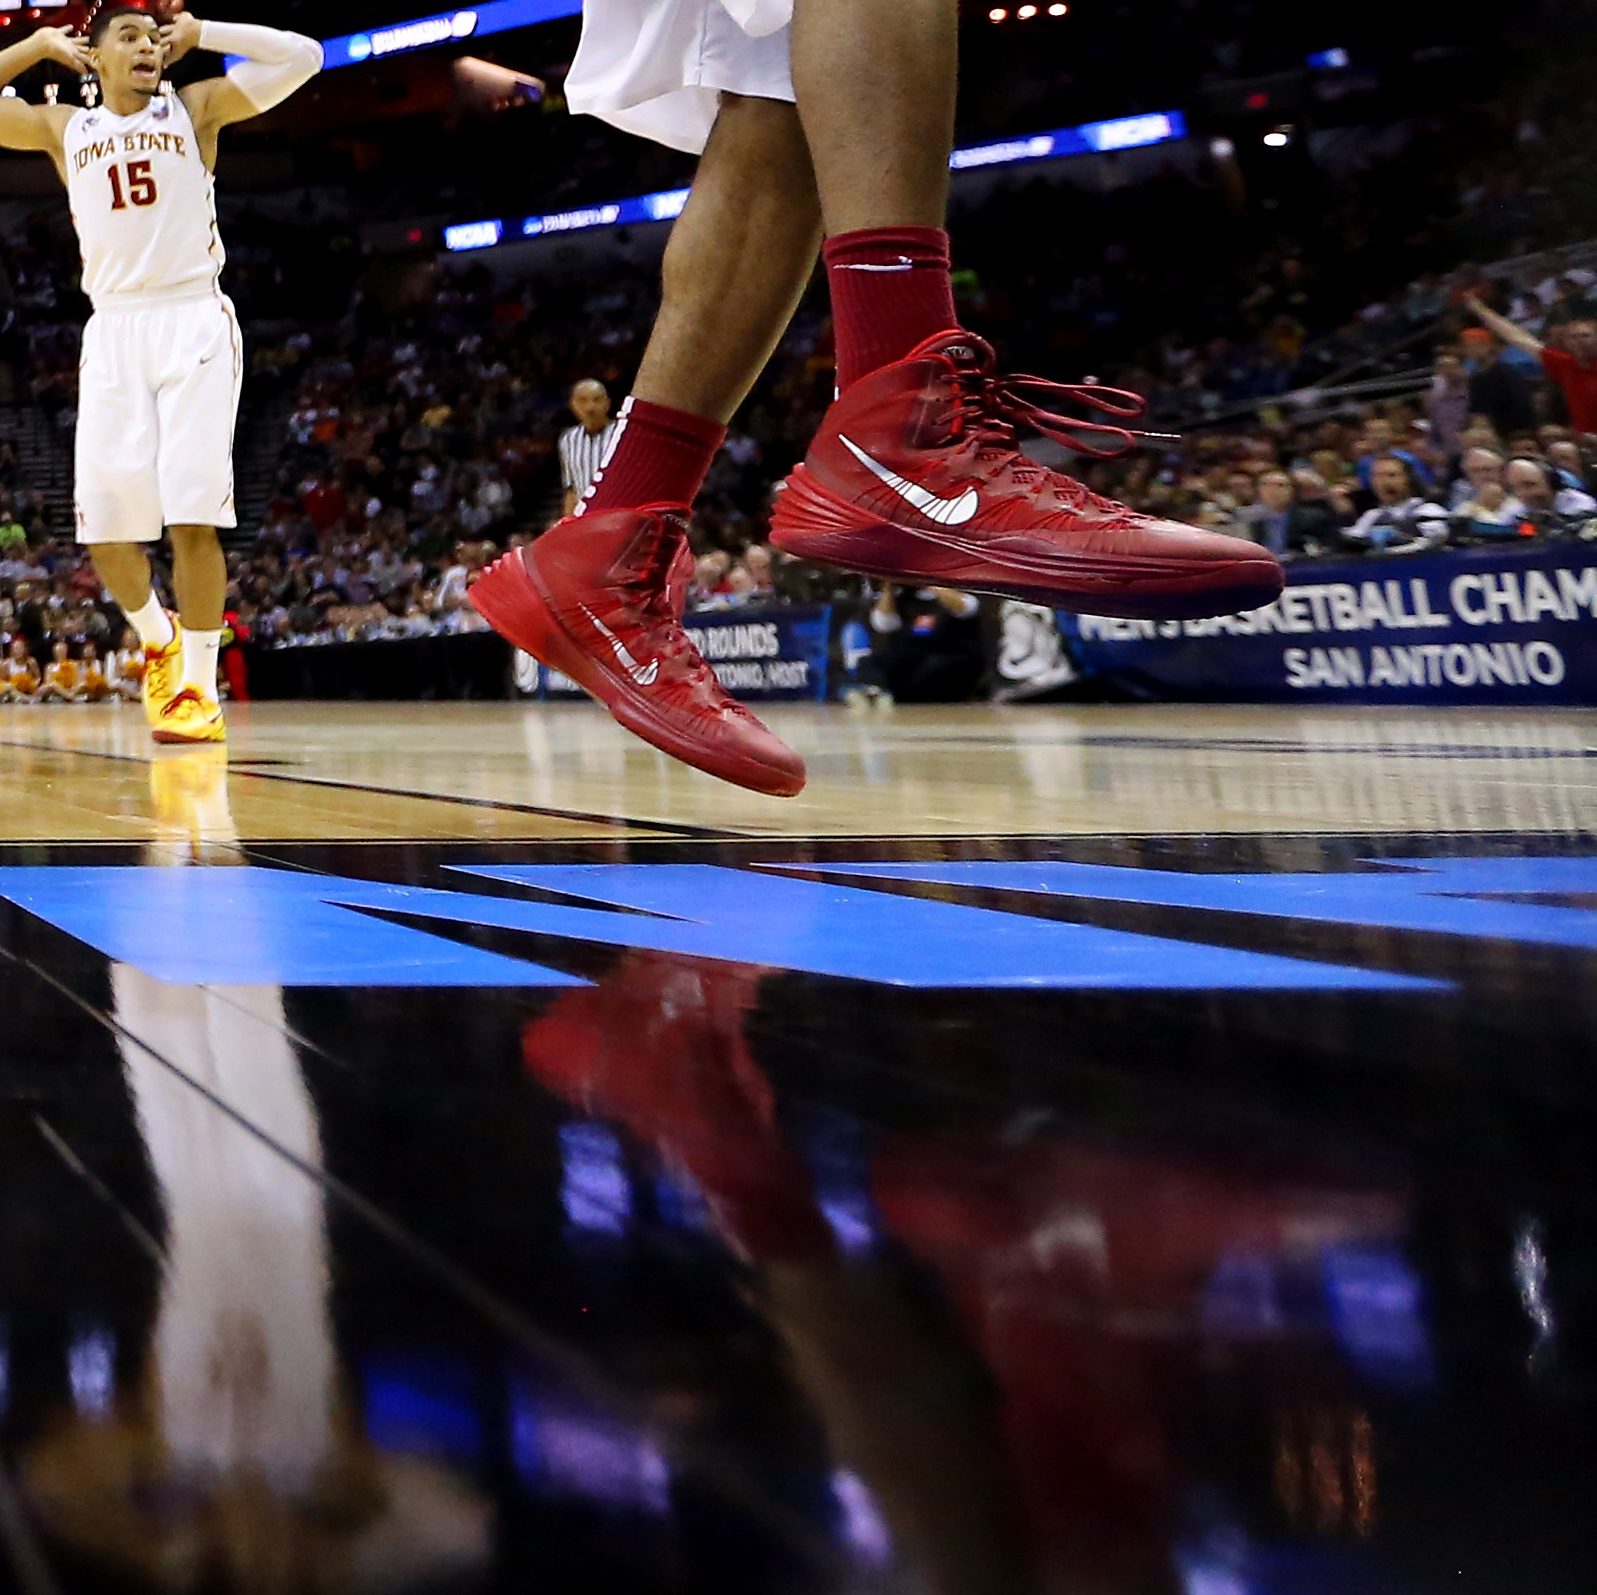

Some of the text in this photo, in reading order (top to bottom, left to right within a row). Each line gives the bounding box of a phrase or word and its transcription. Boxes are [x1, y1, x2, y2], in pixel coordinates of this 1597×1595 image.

[73, 132, 187, 175] IOWA STATE
[106, 158, 158, 212] 15
[707, 622, 780, 659] ROUNDS
[1283, 640, 1566, 689] SAN ANTONIO
